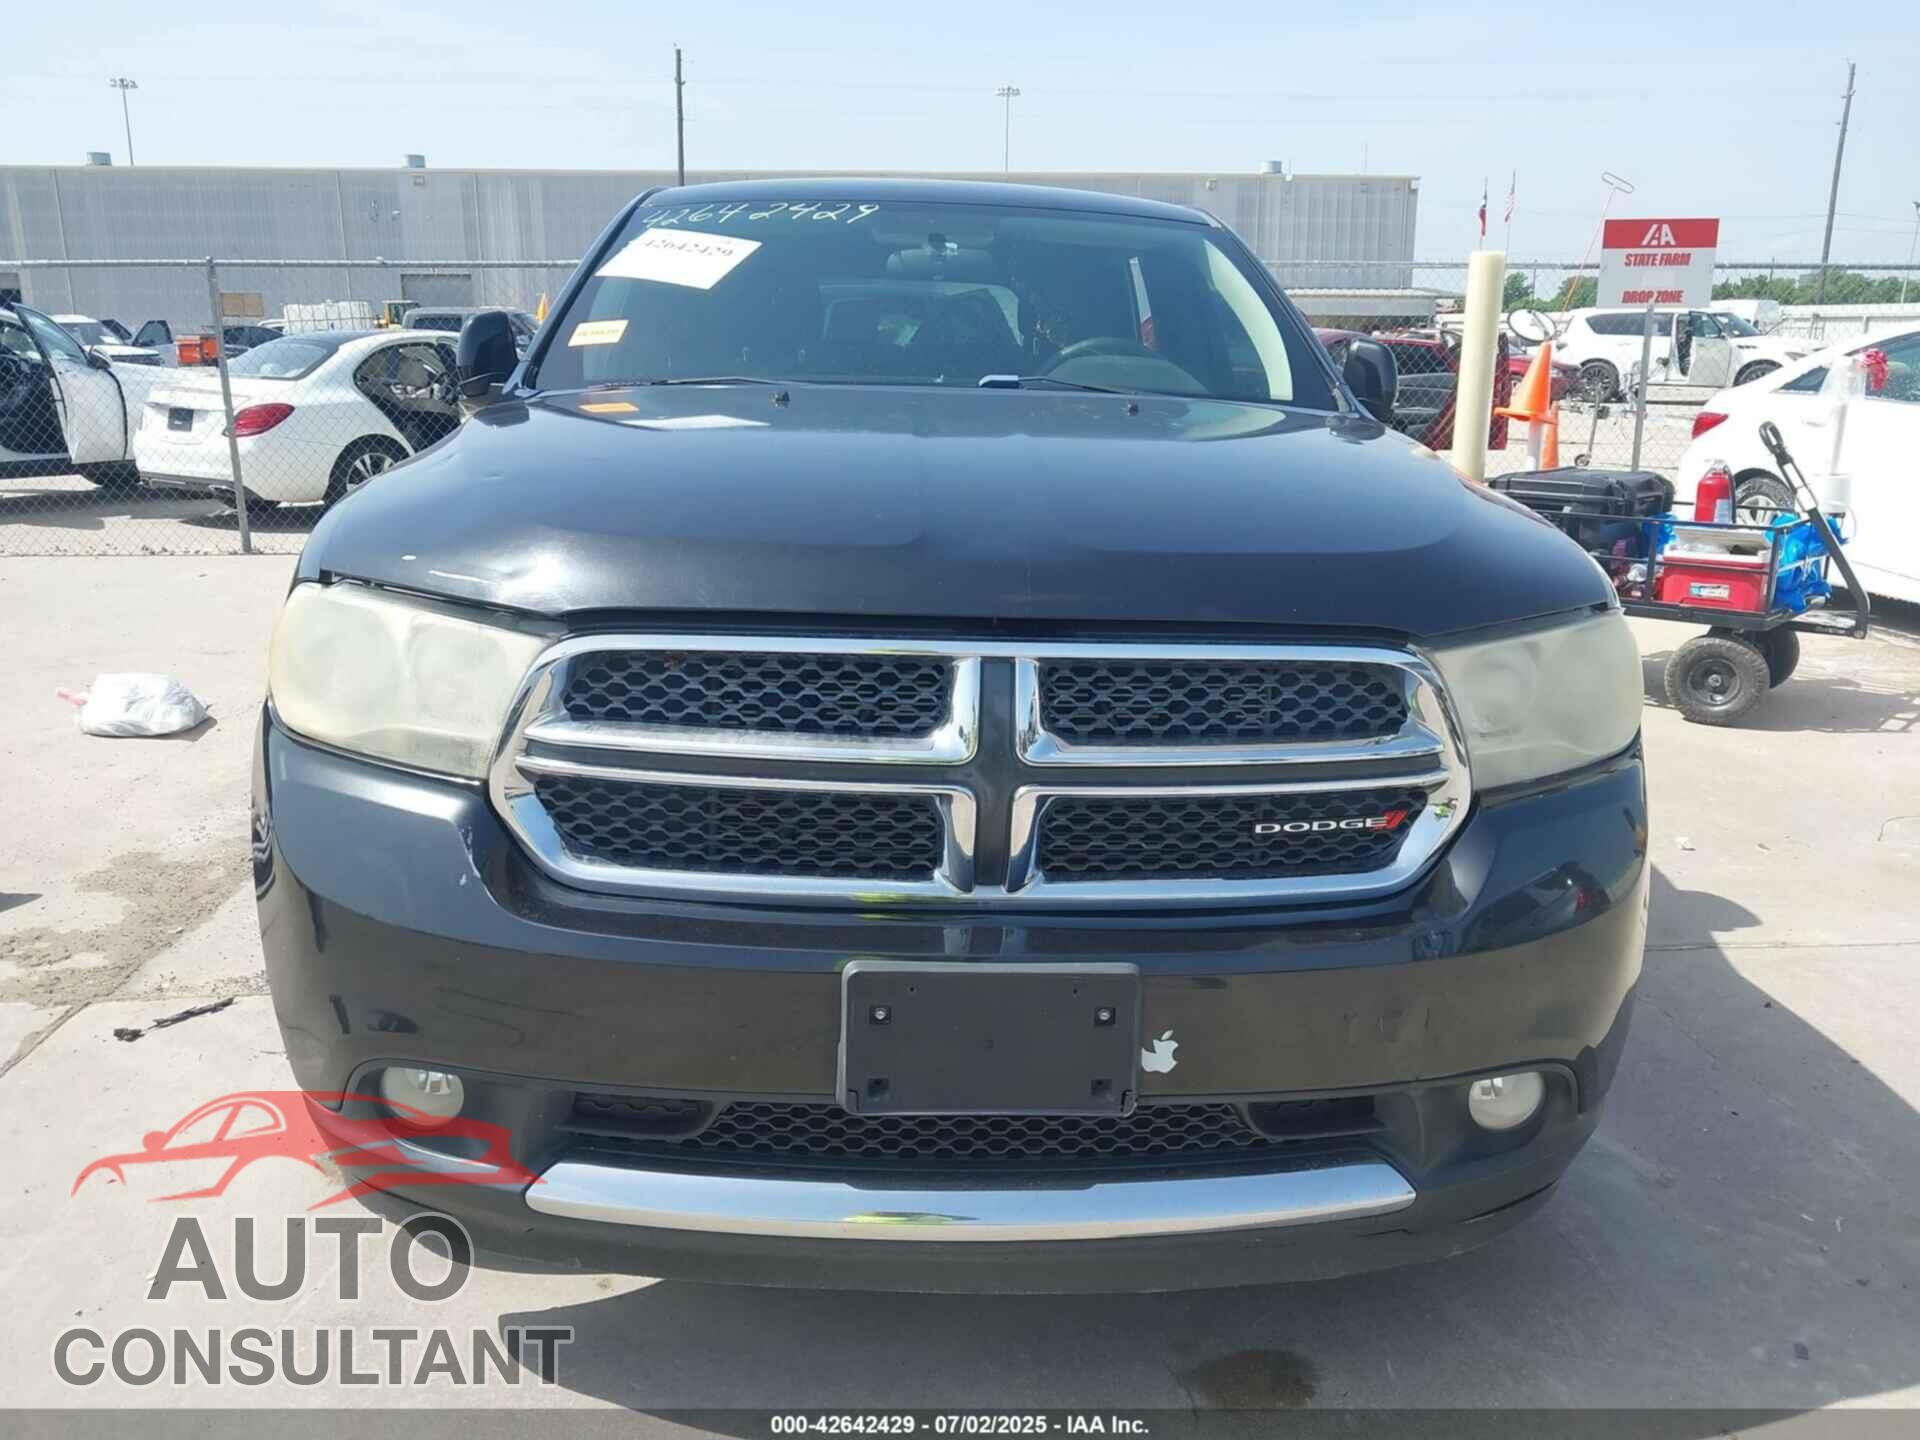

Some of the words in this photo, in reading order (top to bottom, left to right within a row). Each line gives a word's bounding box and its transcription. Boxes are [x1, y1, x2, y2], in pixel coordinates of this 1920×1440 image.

[642, 202, 880, 228] 42642429
[1624, 253, 1660, 267] STATE
[1659, 252, 1692, 266] FARM
[1622, 291, 1655, 304] DROP
[1655, 290, 1685, 303] ZONE
[1254, 816, 1388, 834] DODGE
